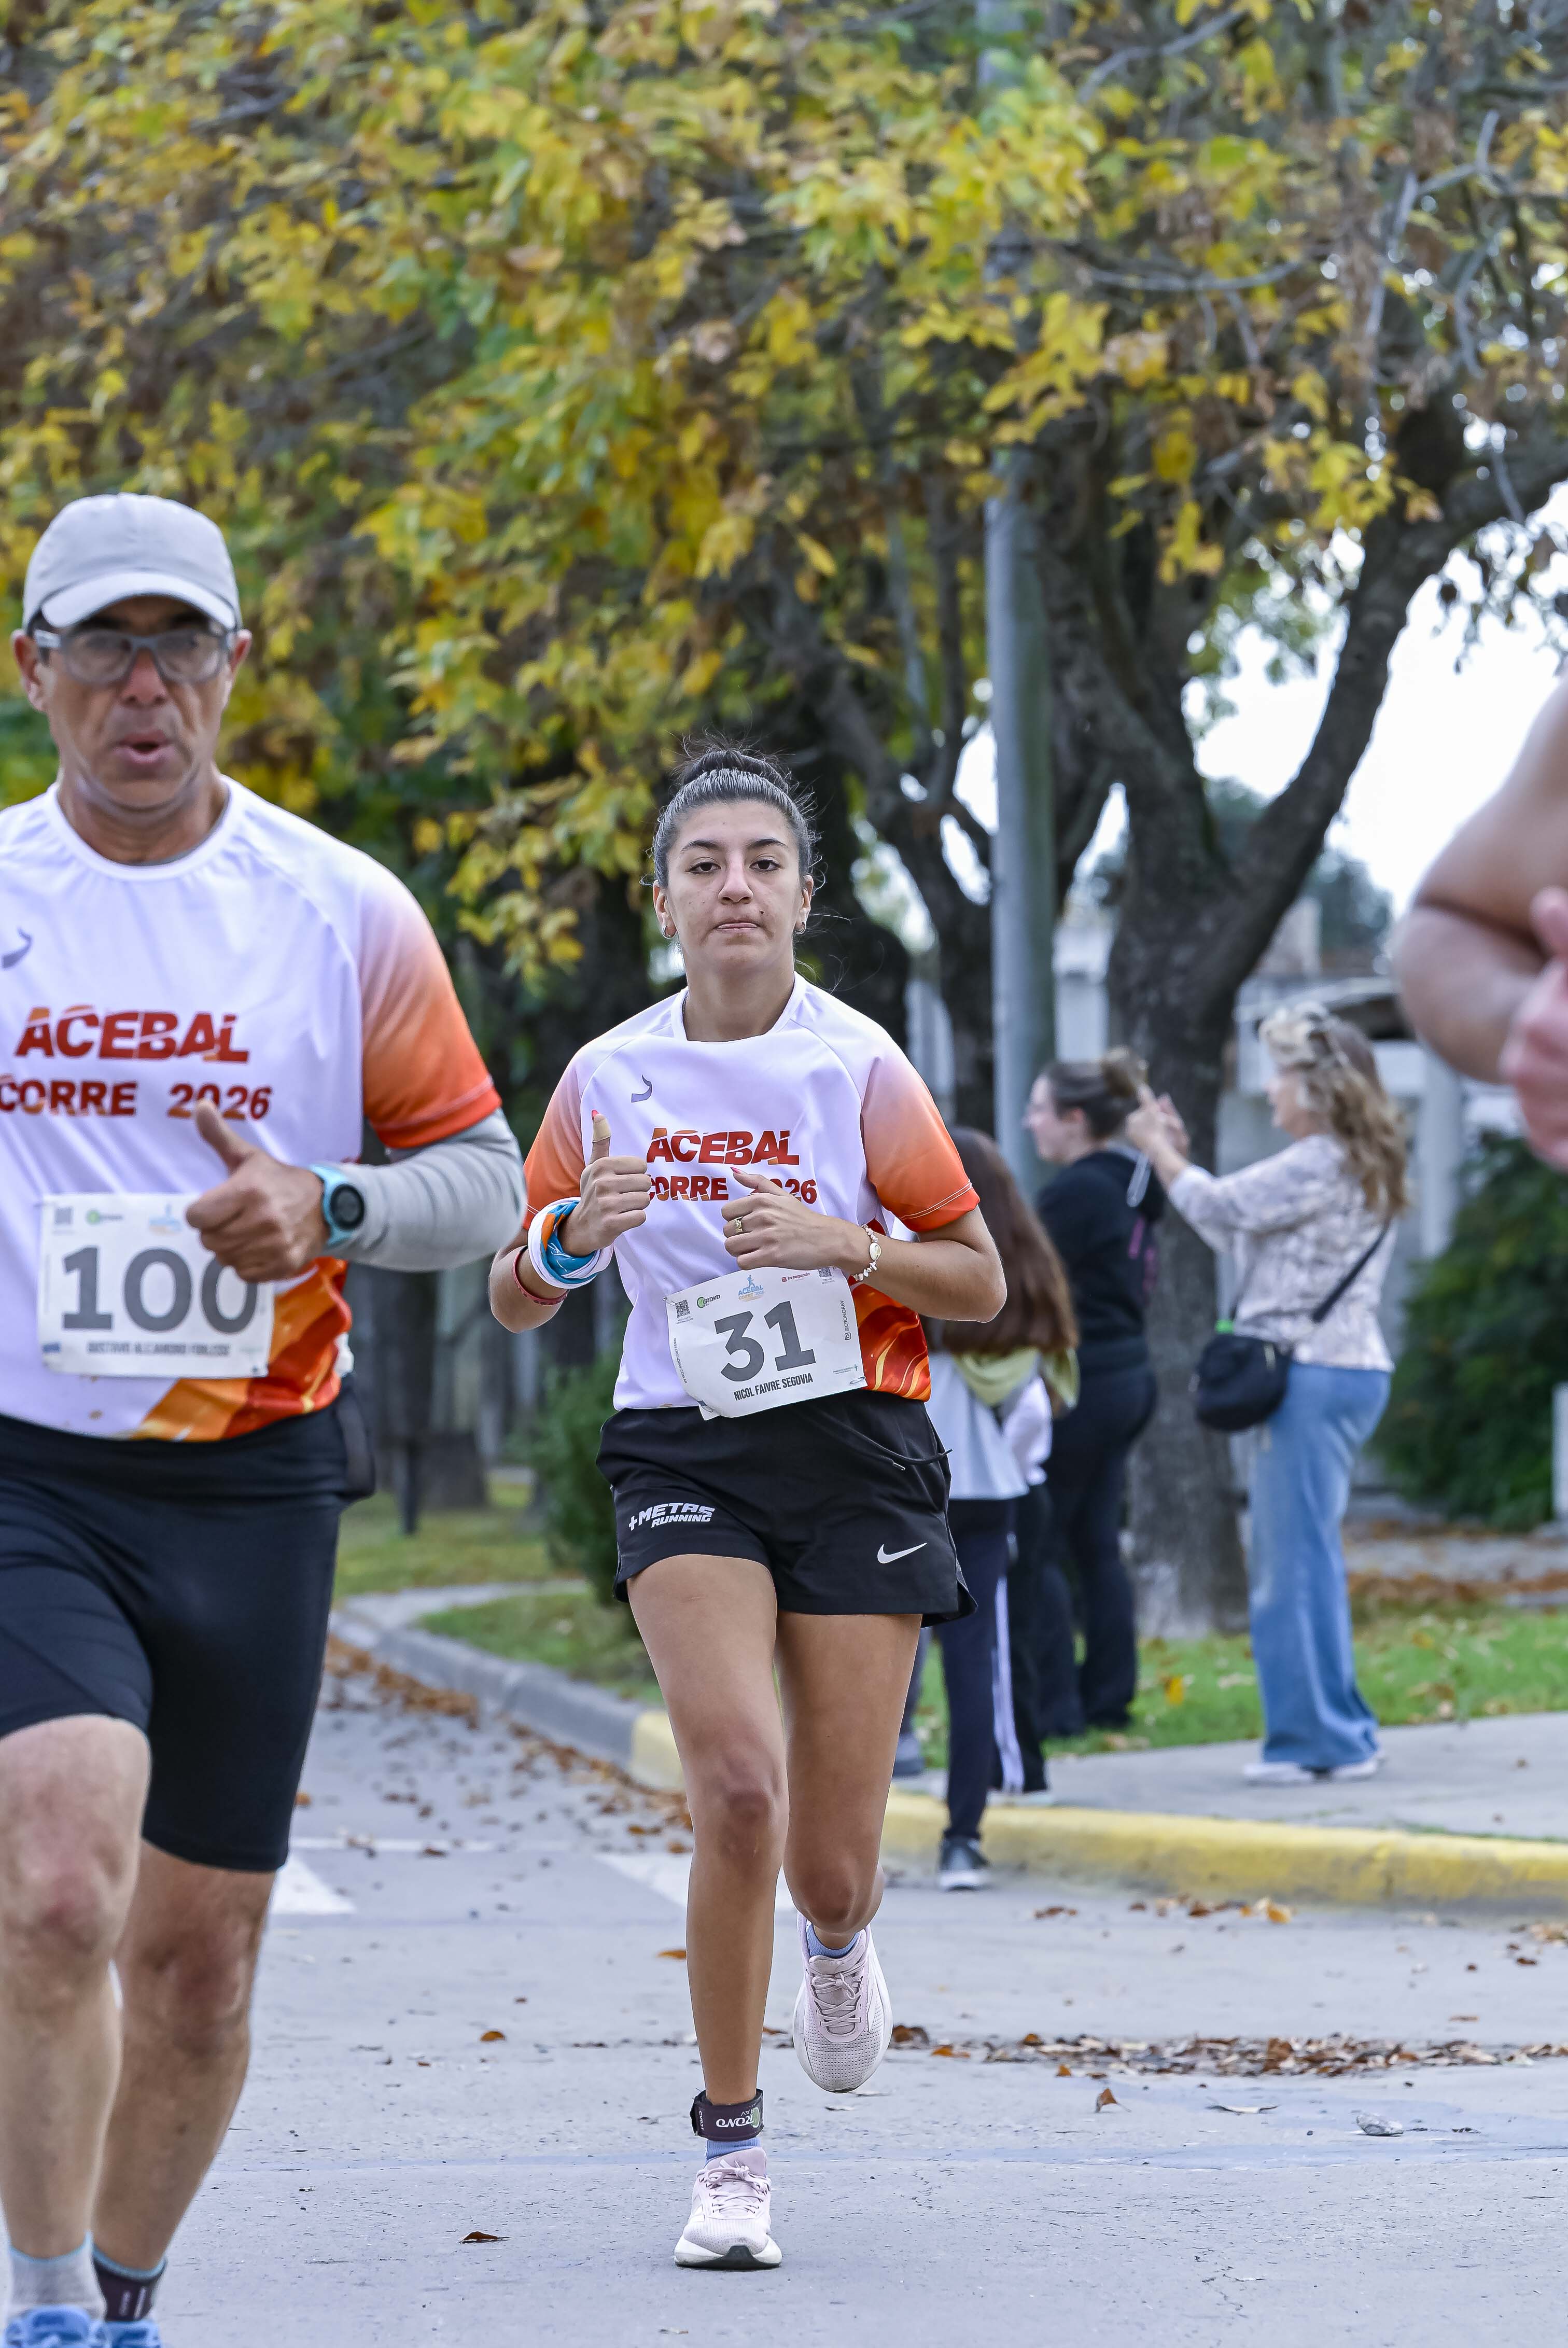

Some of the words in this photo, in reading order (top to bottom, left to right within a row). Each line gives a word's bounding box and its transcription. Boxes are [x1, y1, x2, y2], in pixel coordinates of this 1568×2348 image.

[15, 1005, 249, 1063] ACEBAL
[0, 1075, 137, 1116] CORRE
[646, 1127, 800, 1166] ACEBAL
[62, 1246, 258, 1334] 100
[839, 1300, 849, 1331] @CRONORAV
[714, 1301, 816, 1382] 31
[733, 1387, 754, 1401] NICOL
[754, 1379, 781, 1395] FAIVRE
[781, 1373, 813, 1388] SEGOVIA
[651, 1514, 711, 1528] RUNNING
